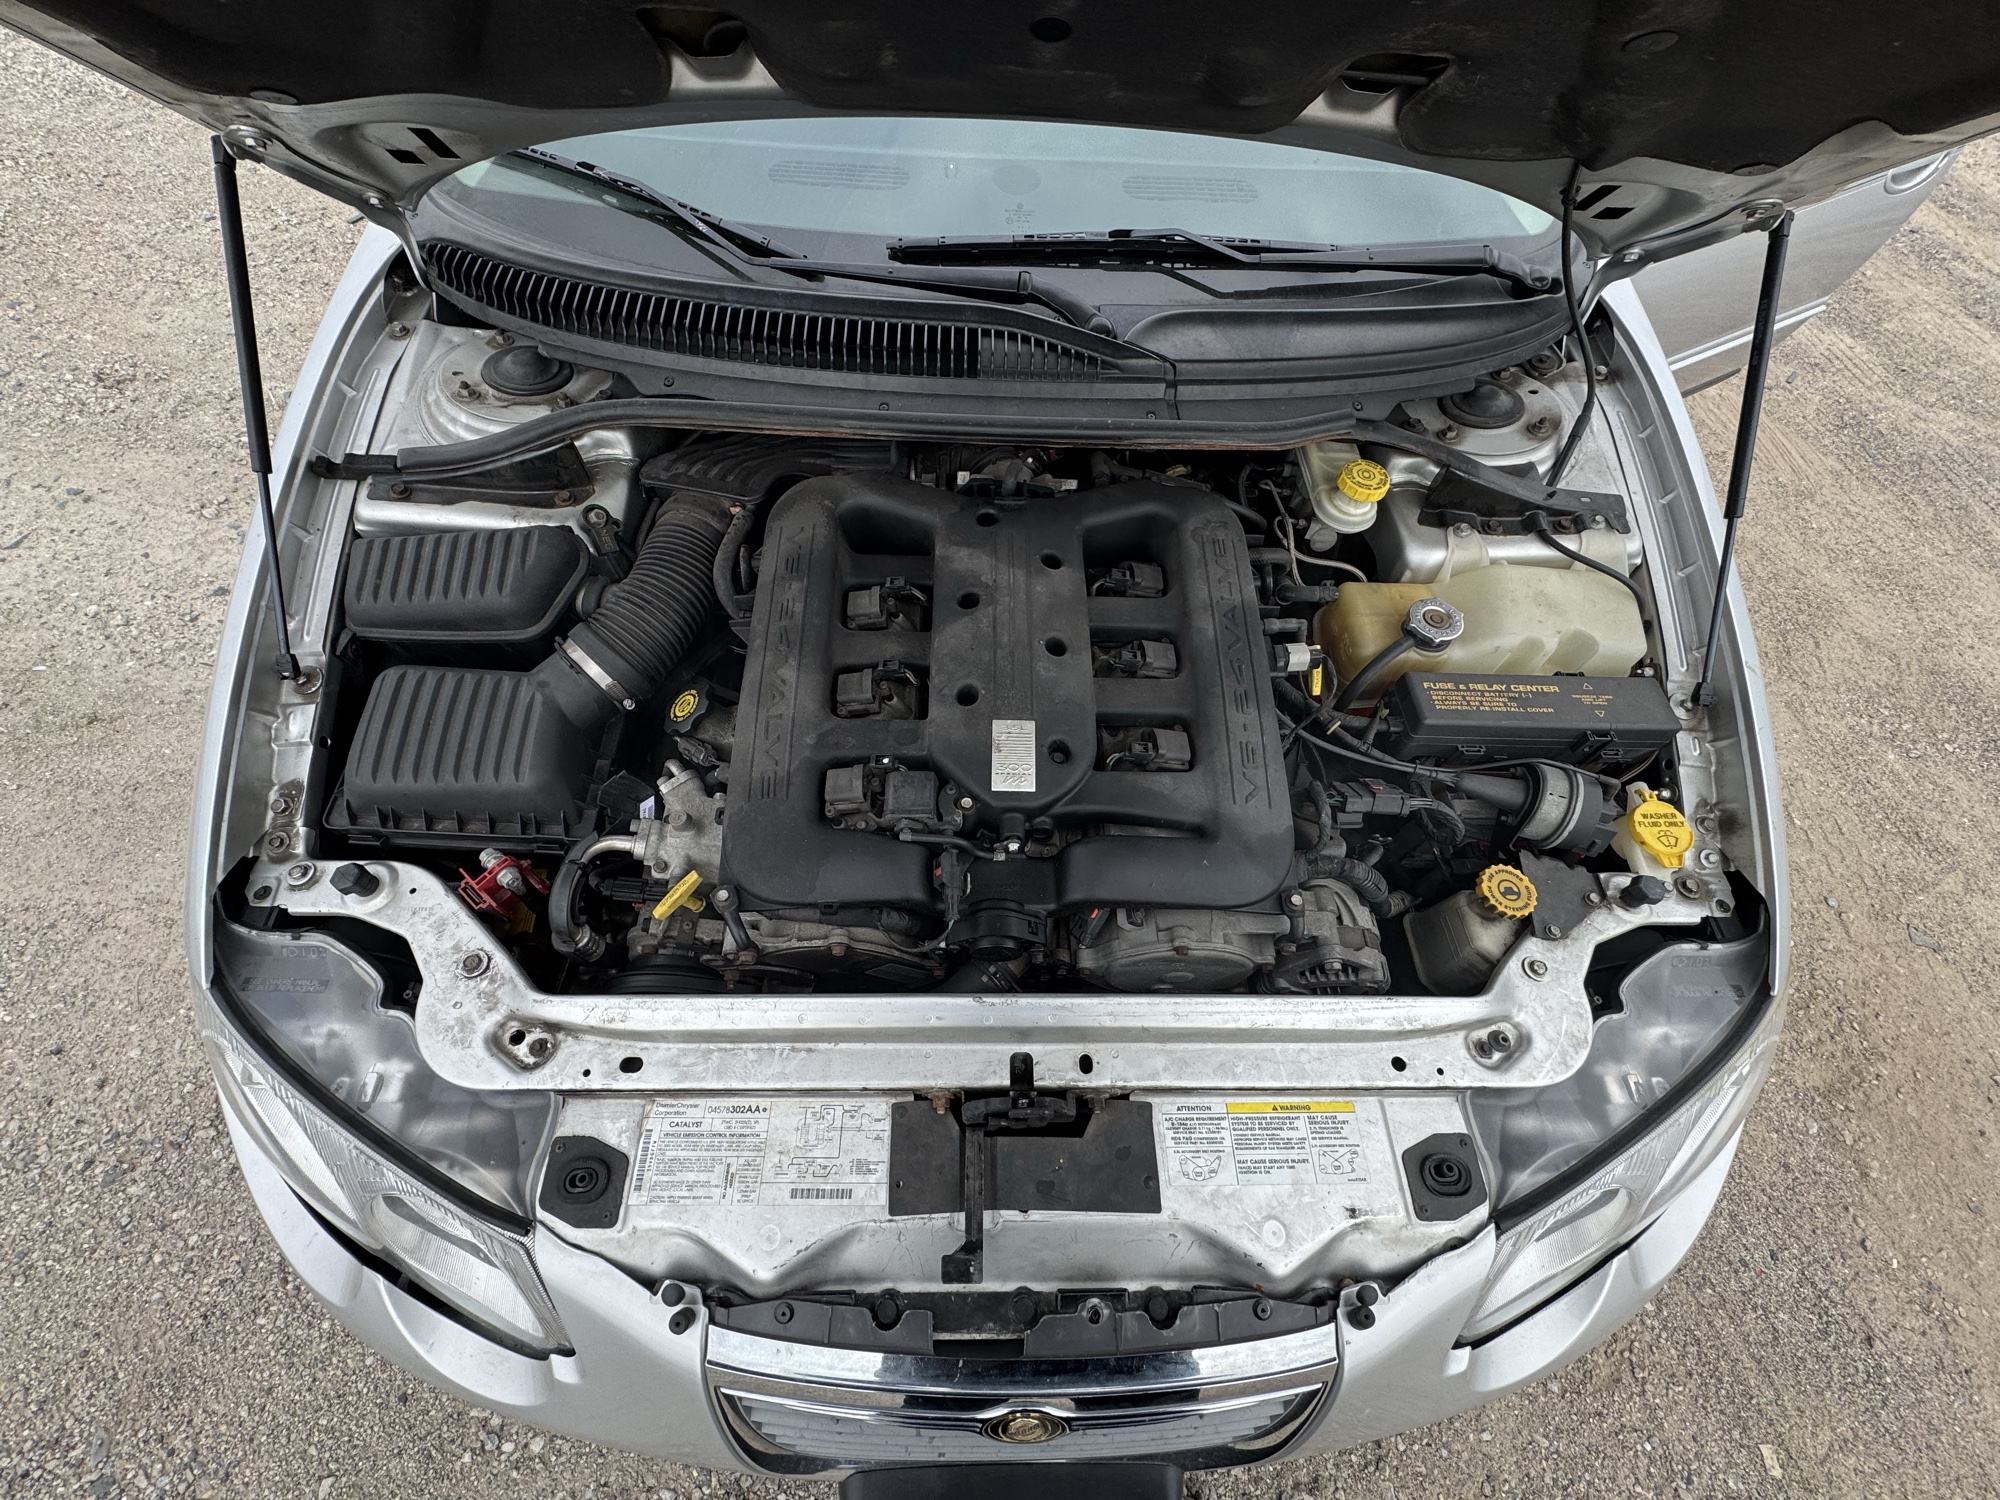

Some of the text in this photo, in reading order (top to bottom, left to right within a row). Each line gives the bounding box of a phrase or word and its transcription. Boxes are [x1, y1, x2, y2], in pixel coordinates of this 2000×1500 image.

[599, 530, 615, 550] NEG
[1211, 536, 1242, 652] VALVE
[1468, 683, 1506, 691] RELAY
[1510, 684, 1560, 692] CENTER
[759, 655, 790, 801] VALVE
[996, 762, 1033, 772] 300
[1640, 812, 1678, 820] WASHER
[1637, 820, 1685, 828] FLUID ONLY
[1486, 868, 1524, 883] USE APPROVED
[1486, 884, 1532, 912] POWER STEERING FLUID
[656, 1102, 700, 1110] DaimlerChrysler
[707, 1105, 761, 1114] 04578302AA
